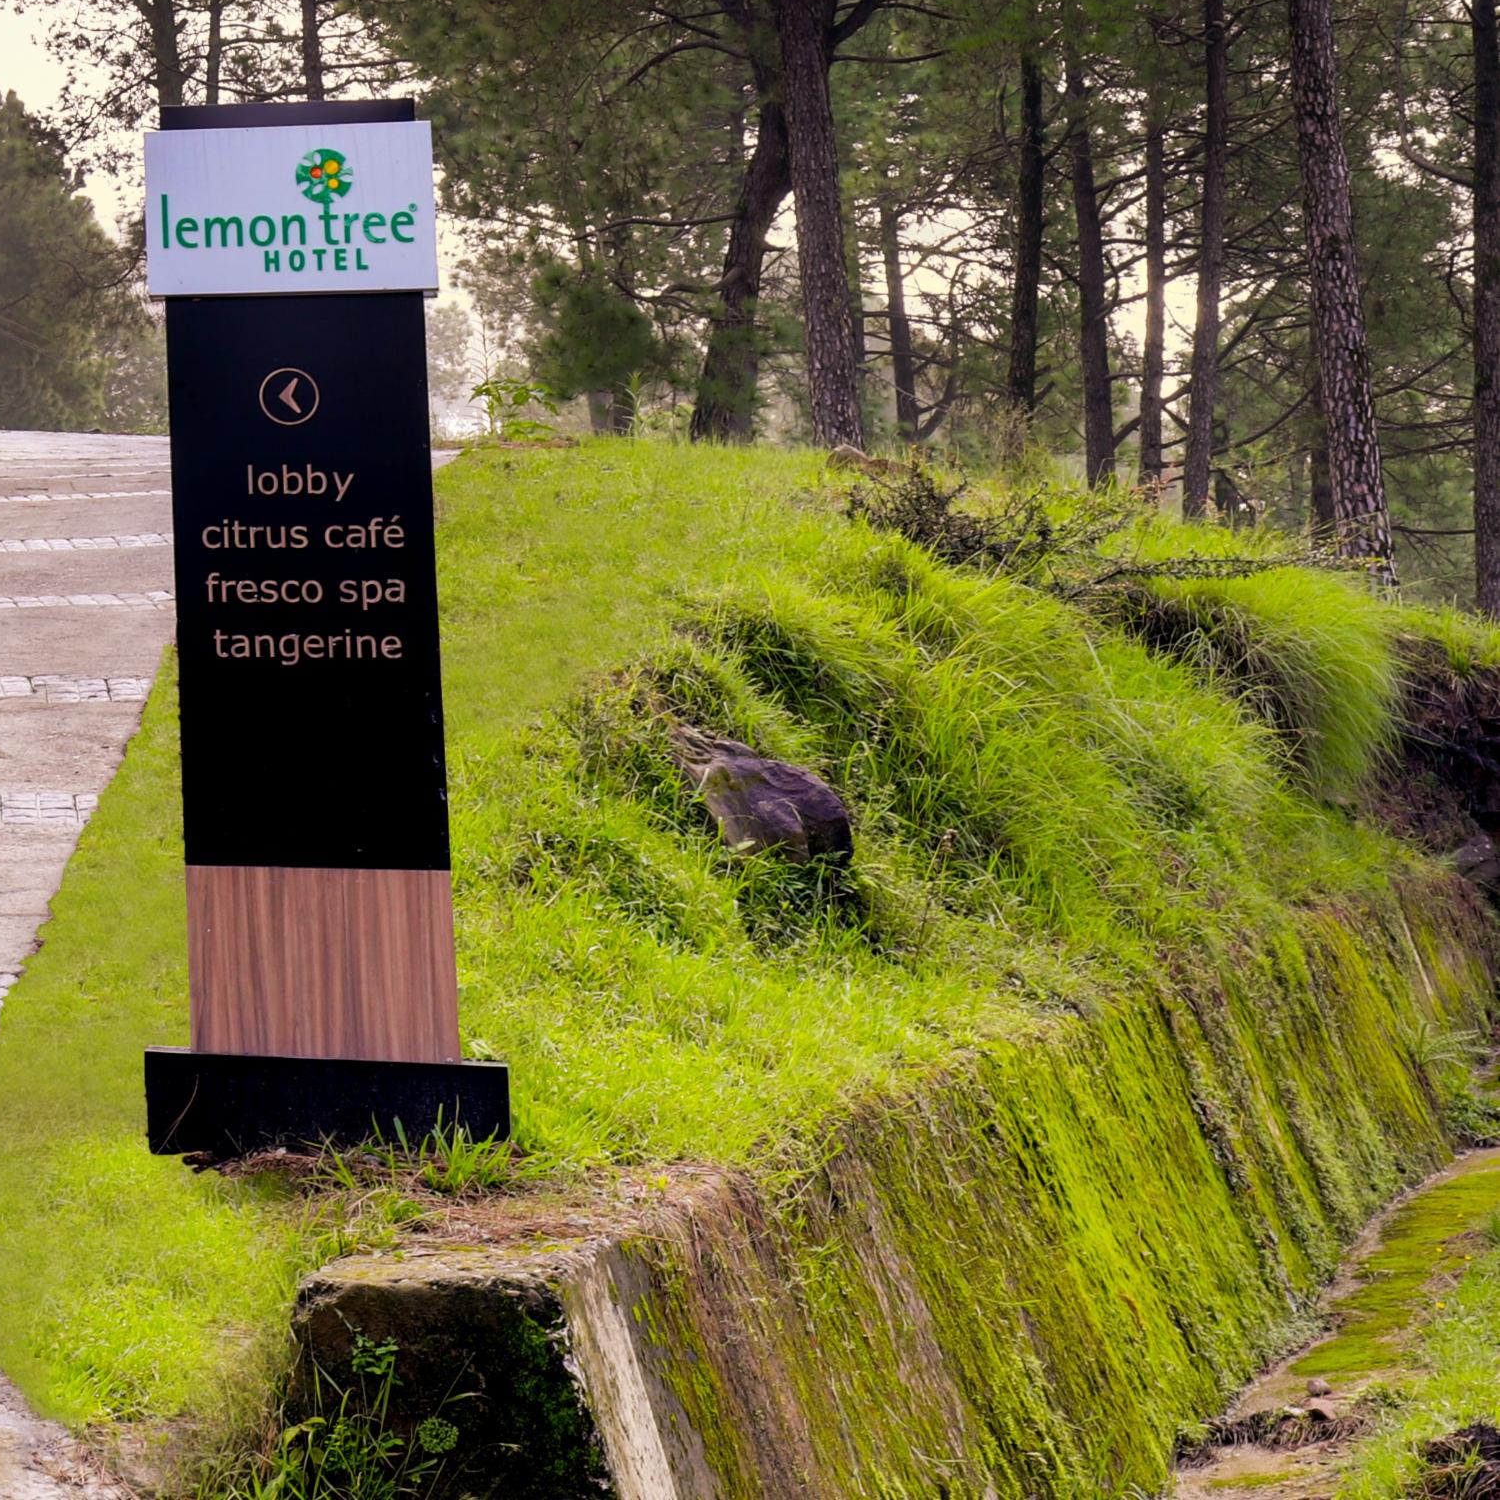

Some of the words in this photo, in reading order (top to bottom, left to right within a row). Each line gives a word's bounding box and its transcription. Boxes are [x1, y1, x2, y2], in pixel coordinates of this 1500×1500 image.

[263, 248, 369, 272] HOTEL
[247, 464, 354, 502] lobby
[201, 518, 309, 549] citrus
[323, 514, 405, 549] café
[205, 572, 323, 603] fresco
[339, 578, 406, 610] spa
[213, 628, 402, 665] tangerine
